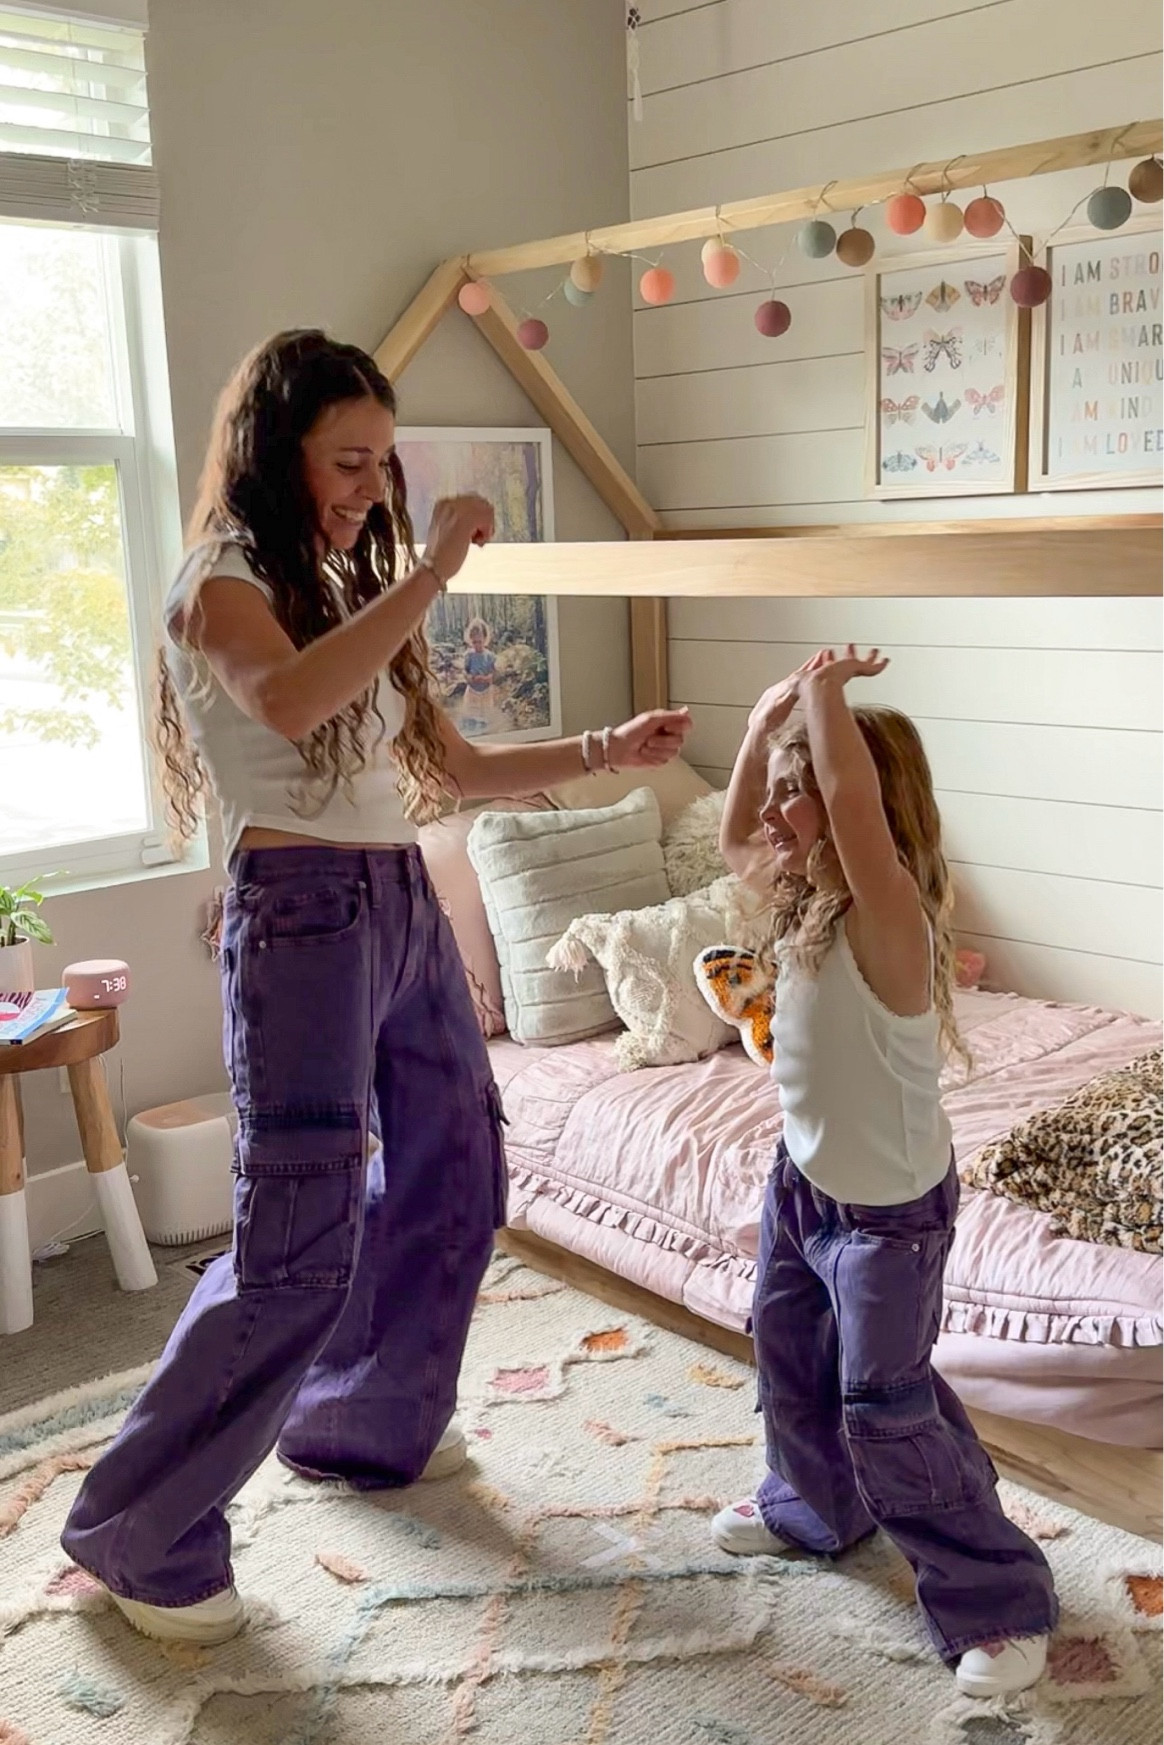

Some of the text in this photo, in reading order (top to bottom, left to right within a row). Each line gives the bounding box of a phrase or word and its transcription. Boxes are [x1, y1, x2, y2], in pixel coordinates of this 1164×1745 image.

[1074, 260, 1101, 285] AM
[1109, 251, 1163, 281] STRO
[1109, 287, 1160, 315] BRAV
[1073, 330, 1100, 354] AM
[101, 976, 127, 992] 7:38
